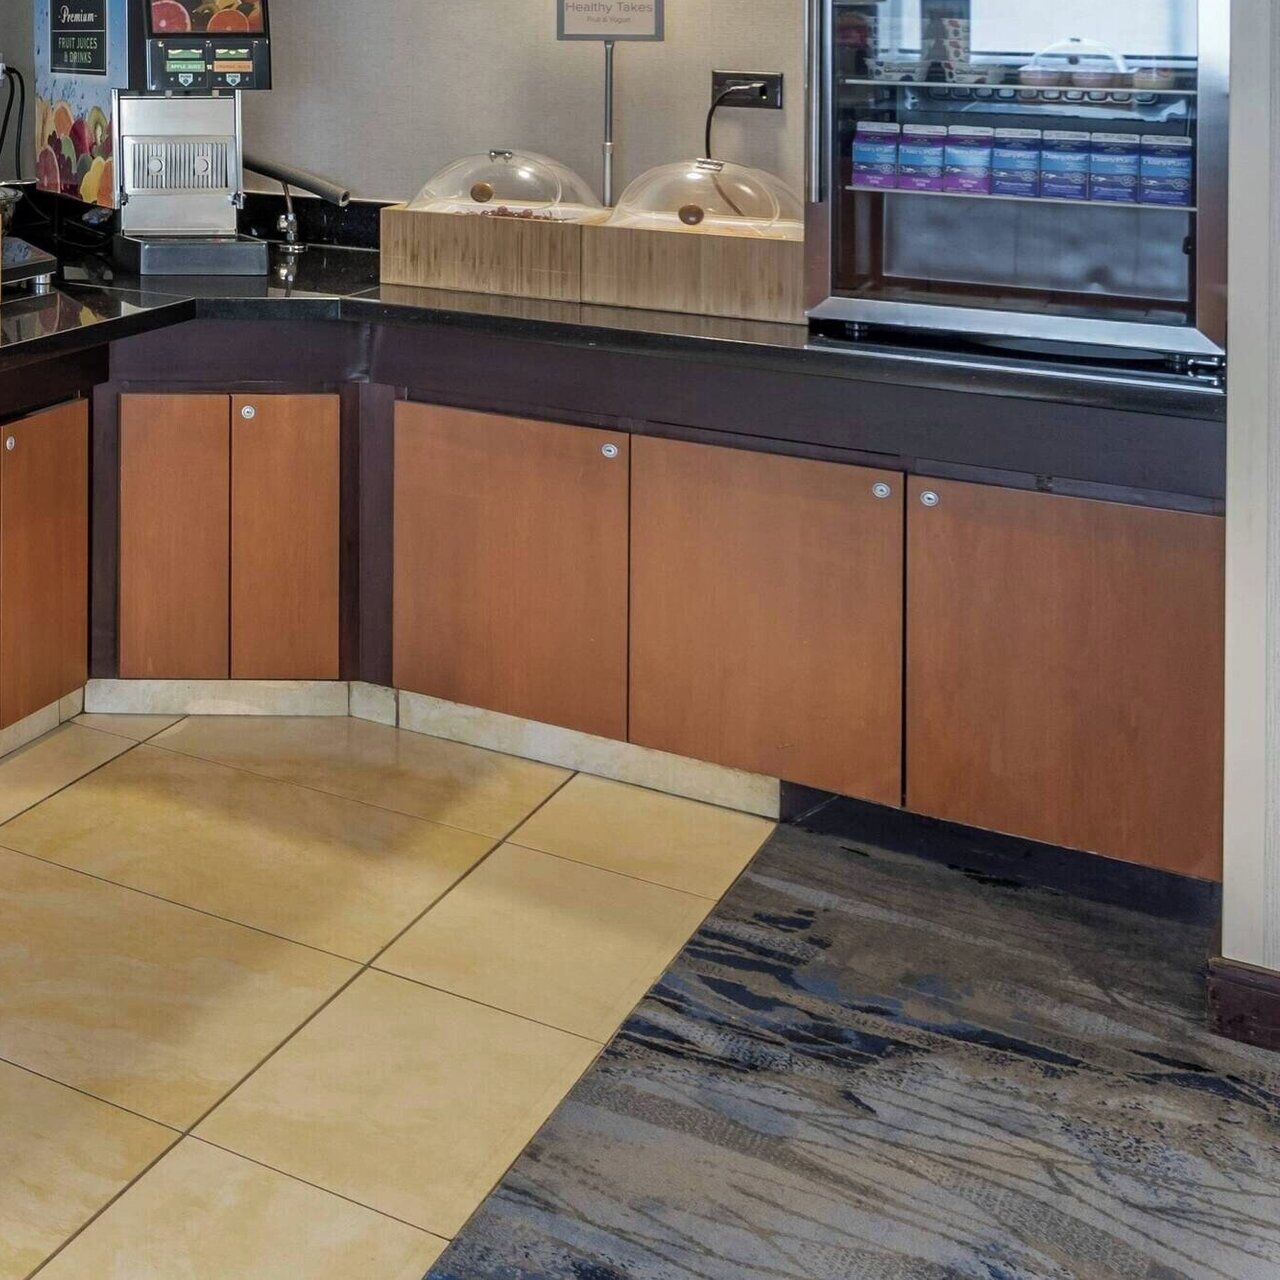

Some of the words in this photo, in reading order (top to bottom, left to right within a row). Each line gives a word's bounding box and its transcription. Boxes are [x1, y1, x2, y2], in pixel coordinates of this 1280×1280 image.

[565, 1, 613, 14] Healthy
[616, 1, 653, 12] Takes
[58, 37, 75, 49] FRUIT
[76, 37, 98, 50] JUICES
[69, 51, 93, 64] DRINKS
